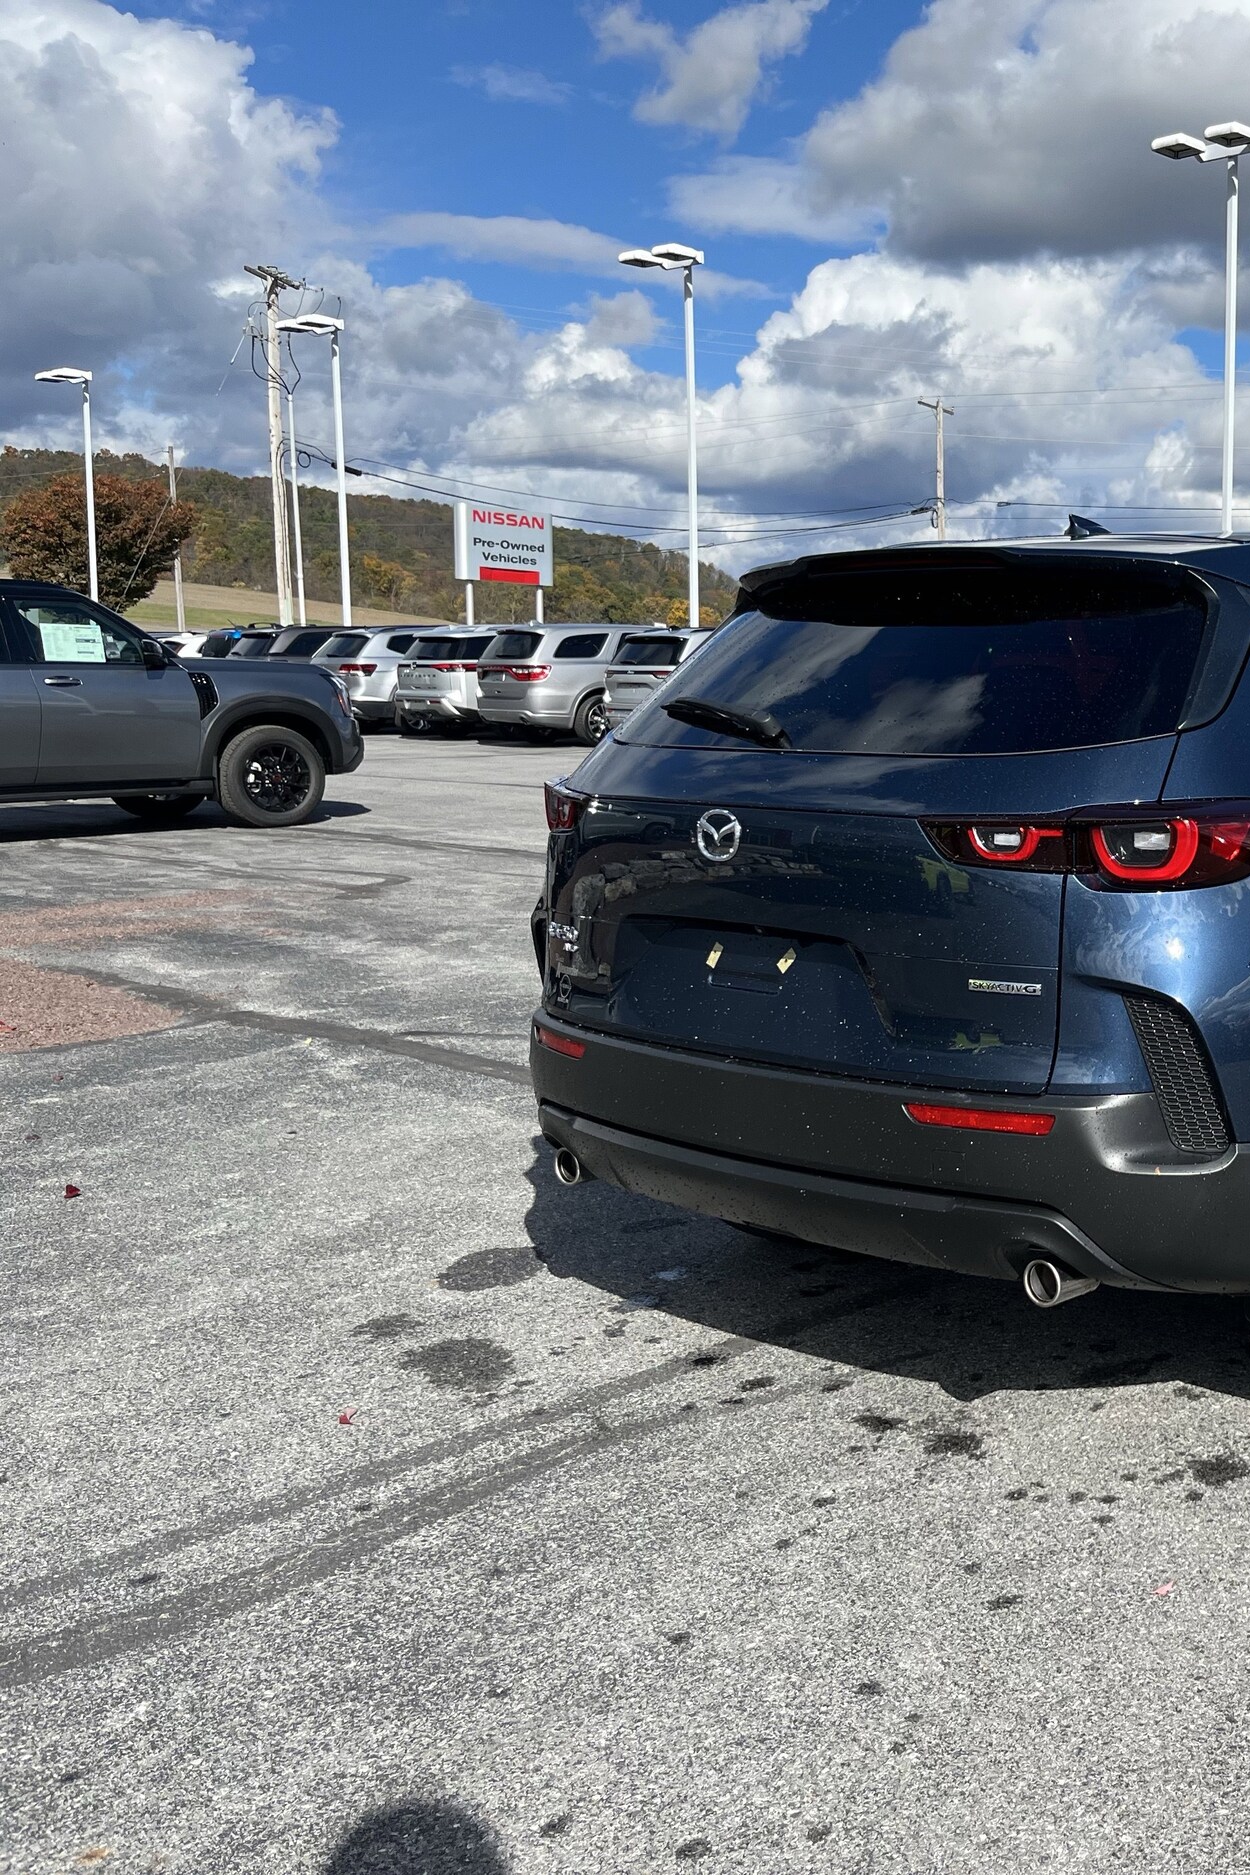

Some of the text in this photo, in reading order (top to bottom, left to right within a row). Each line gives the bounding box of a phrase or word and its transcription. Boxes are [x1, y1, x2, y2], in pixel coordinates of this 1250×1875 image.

[472, 509, 544, 529] NISSAN
[473, 537, 545, 553] Pre-Owned
[482, 551, 537, 566] Vehicles
